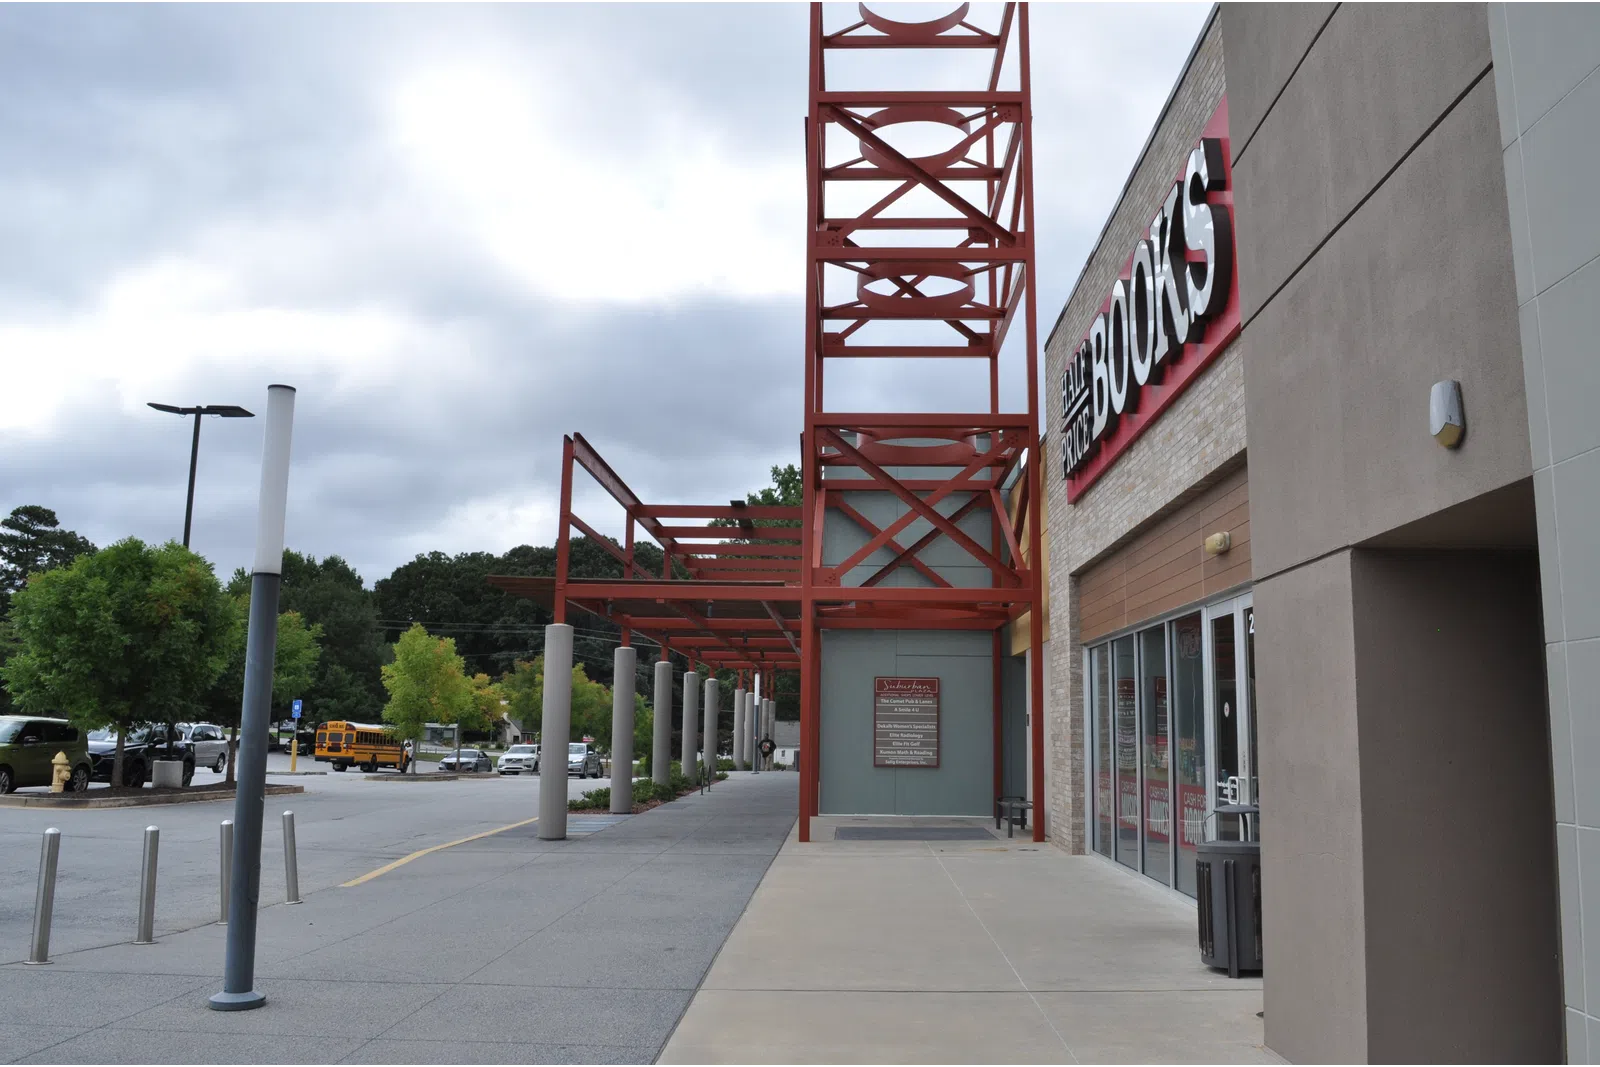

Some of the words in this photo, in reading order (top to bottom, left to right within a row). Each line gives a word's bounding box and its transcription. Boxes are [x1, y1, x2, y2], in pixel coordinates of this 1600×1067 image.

[1089, 138, 1226, 441] BOOKS
[1061, 339, 1089, 419] HALF
[1061, 405, 1090, 480] PRICE
[884, 680, 931, 691] Suburban
[1149, 785, 1160, 798] CASH
[1183, 792, 1196, 807] CASH
